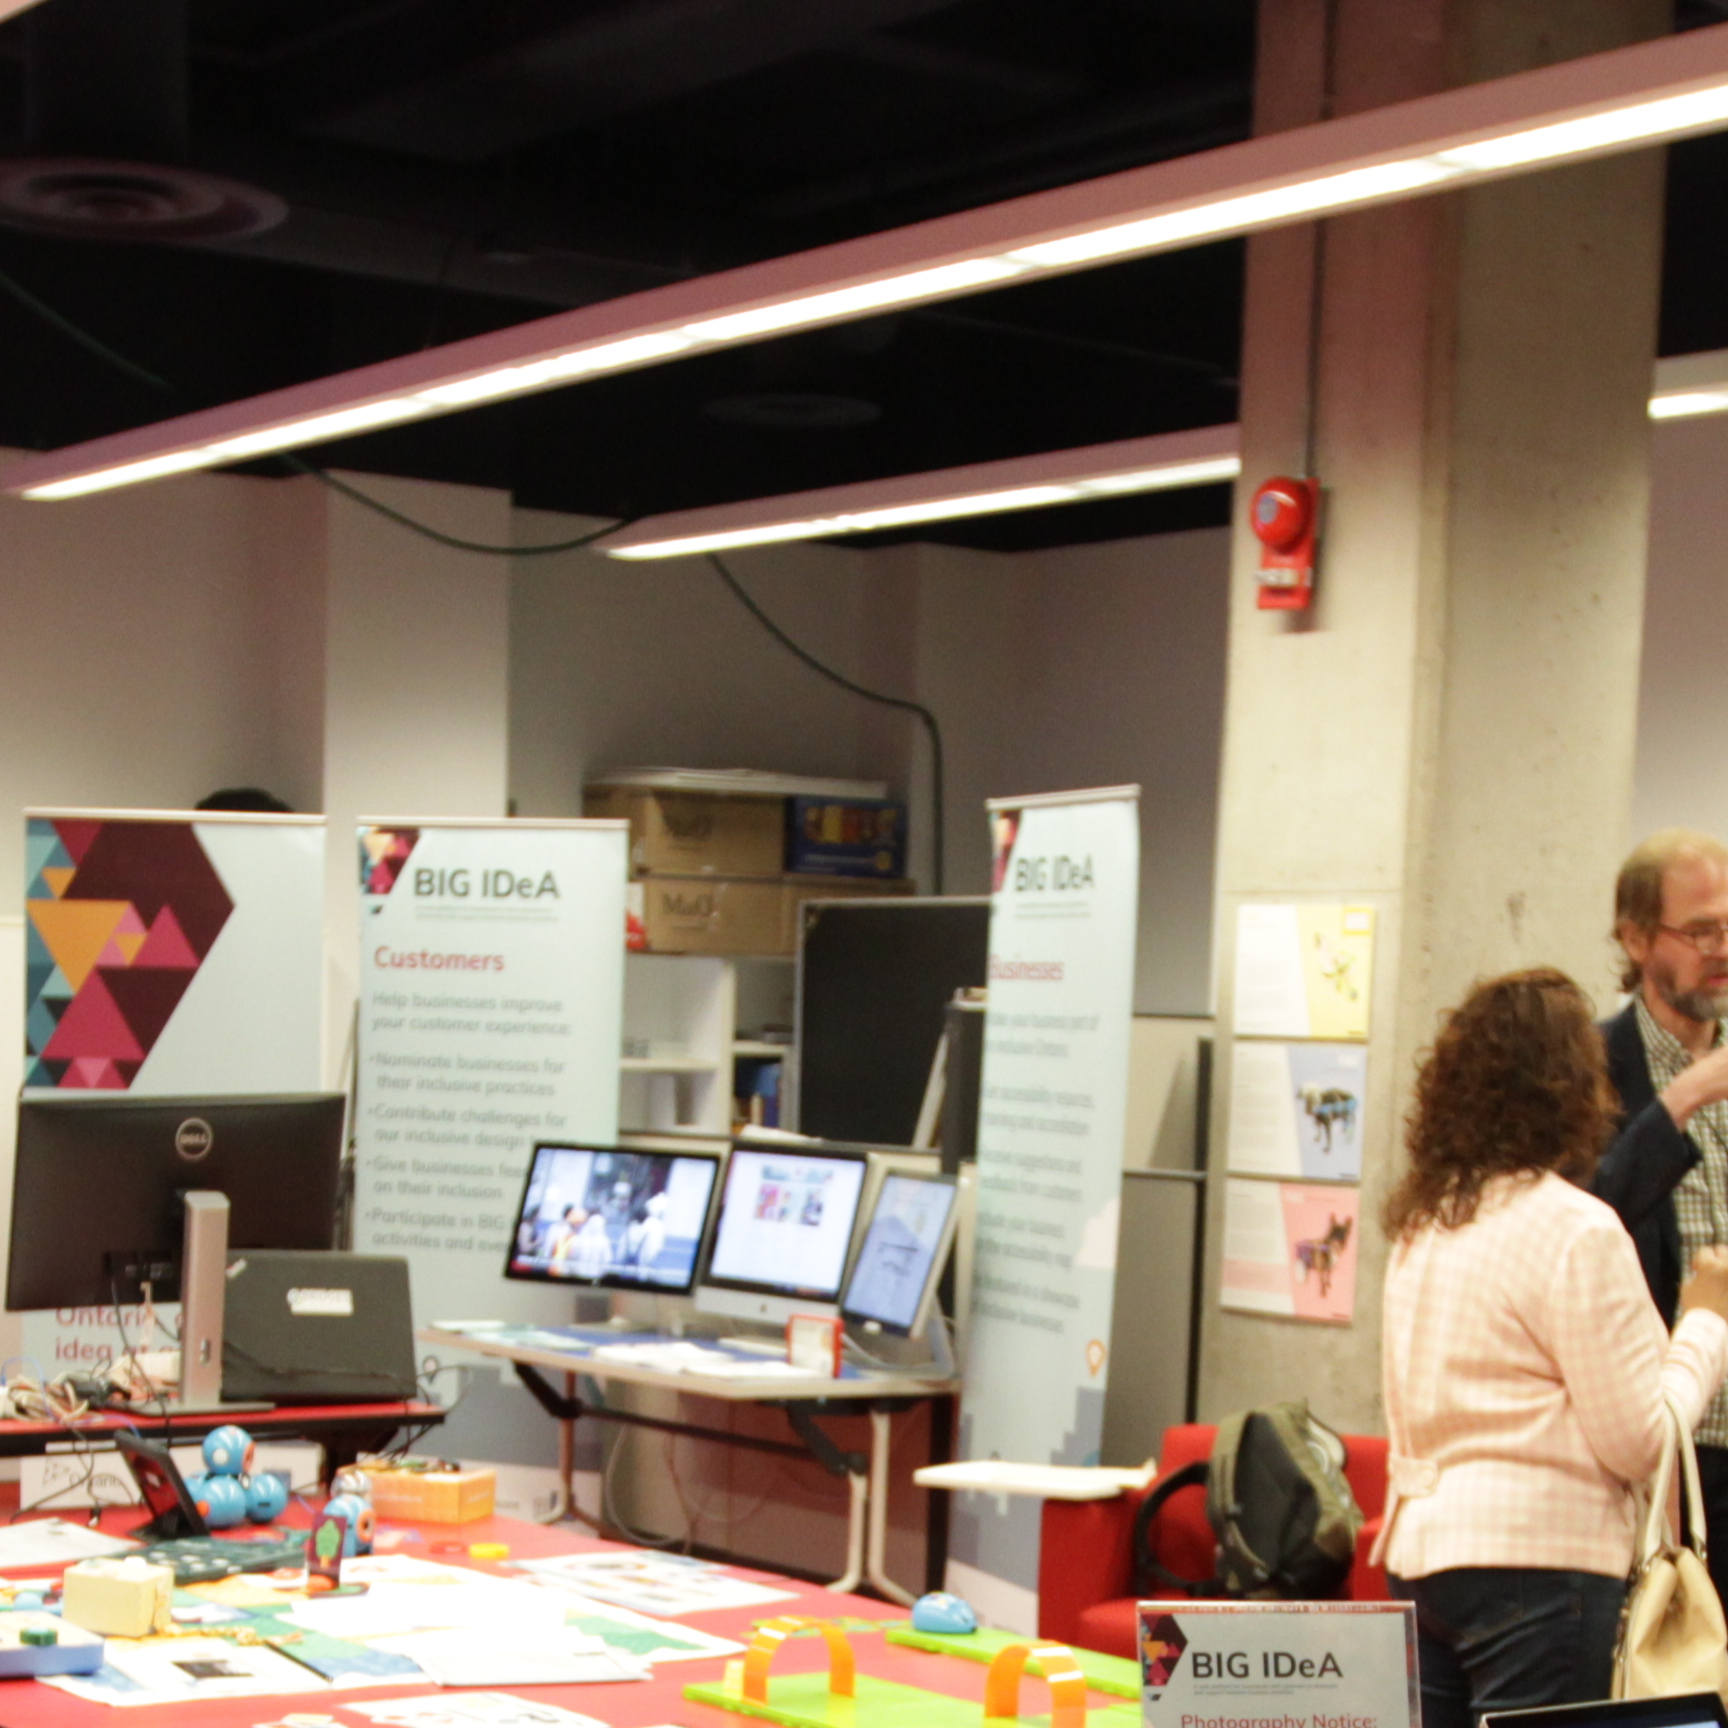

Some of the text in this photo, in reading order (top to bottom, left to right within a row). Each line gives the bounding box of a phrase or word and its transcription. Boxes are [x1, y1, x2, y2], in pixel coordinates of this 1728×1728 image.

[1015, 853, 1095, 892] BIG IDeA
[414, 868, 560, 899] BIG IDeA
[374, 945, 505, 971] Customers
[372, 991, 562, 1015] Help businesses improve
[371, 1019, 405, 1033] your
[409, 1019, 480, 1033] customer
[456, 1054, 539, 1072] businesses
[543, 1058, 566, 1074] for
[377, 1075, 555, 1096] their inclusive practices
[460, 1106, 541, 1128] challenges
[545, 1109, 568, 1127] for
[375, 1127, 524, 1150] our inclusive design
[412, 1156, 494, 1177] businesses
[374, 1180, 503, 1199] on their inclusion
[460, 1213, 473, 1228] in
[478, 1214, 505, 1230] BIG
[372, 1233, 440, 1249] activities
[445, 1234, 473, 1250] and
[1192, 1650, 1345, 1680] BIG IDeA
